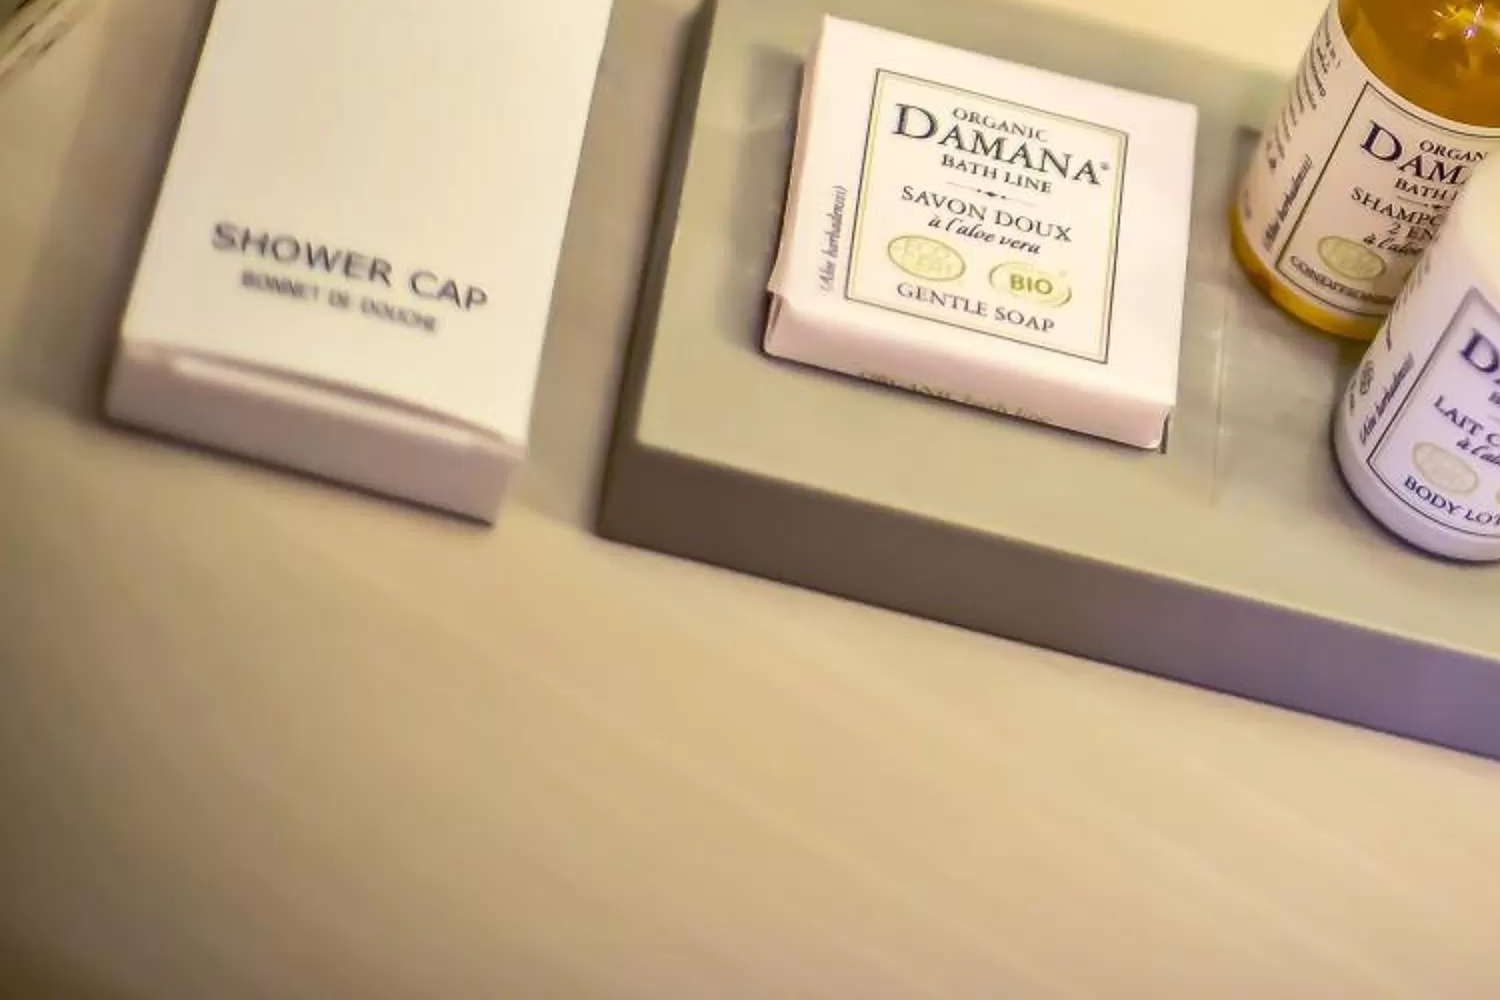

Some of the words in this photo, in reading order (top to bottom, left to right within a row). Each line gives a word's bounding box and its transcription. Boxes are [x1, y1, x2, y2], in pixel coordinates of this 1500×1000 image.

[951, 106, 1048, 142] ORGANIC
[1359, 119, 1470, 185] DAM
[1419, 139, 1489, 162] ORGAN
[941, 153, 999, 180] BATH
[1003, 168, 1053, 195] LINE
[1394, 177, 1450, 201] BATH
[902, 185, 988, 221] SAVON
[993, 210, 1072, 243] DOUX
[1351, 186, 1442, 227] SHAMPO
[999, 236, 1041, 254] vera
[1388, 221, 1401, 235] 2
[211, 221, 394, 288] SHOWER
[409, 269, 488, 312] CAP
[1009, 272, 1054, 295] BIO
[896, 282, 988, 317] GENTLE
[994, 306, 1055, 333] SOAP
[1433, 395, 1485, 436] LAIT
[1403, 475, 1464, 516] BODY
